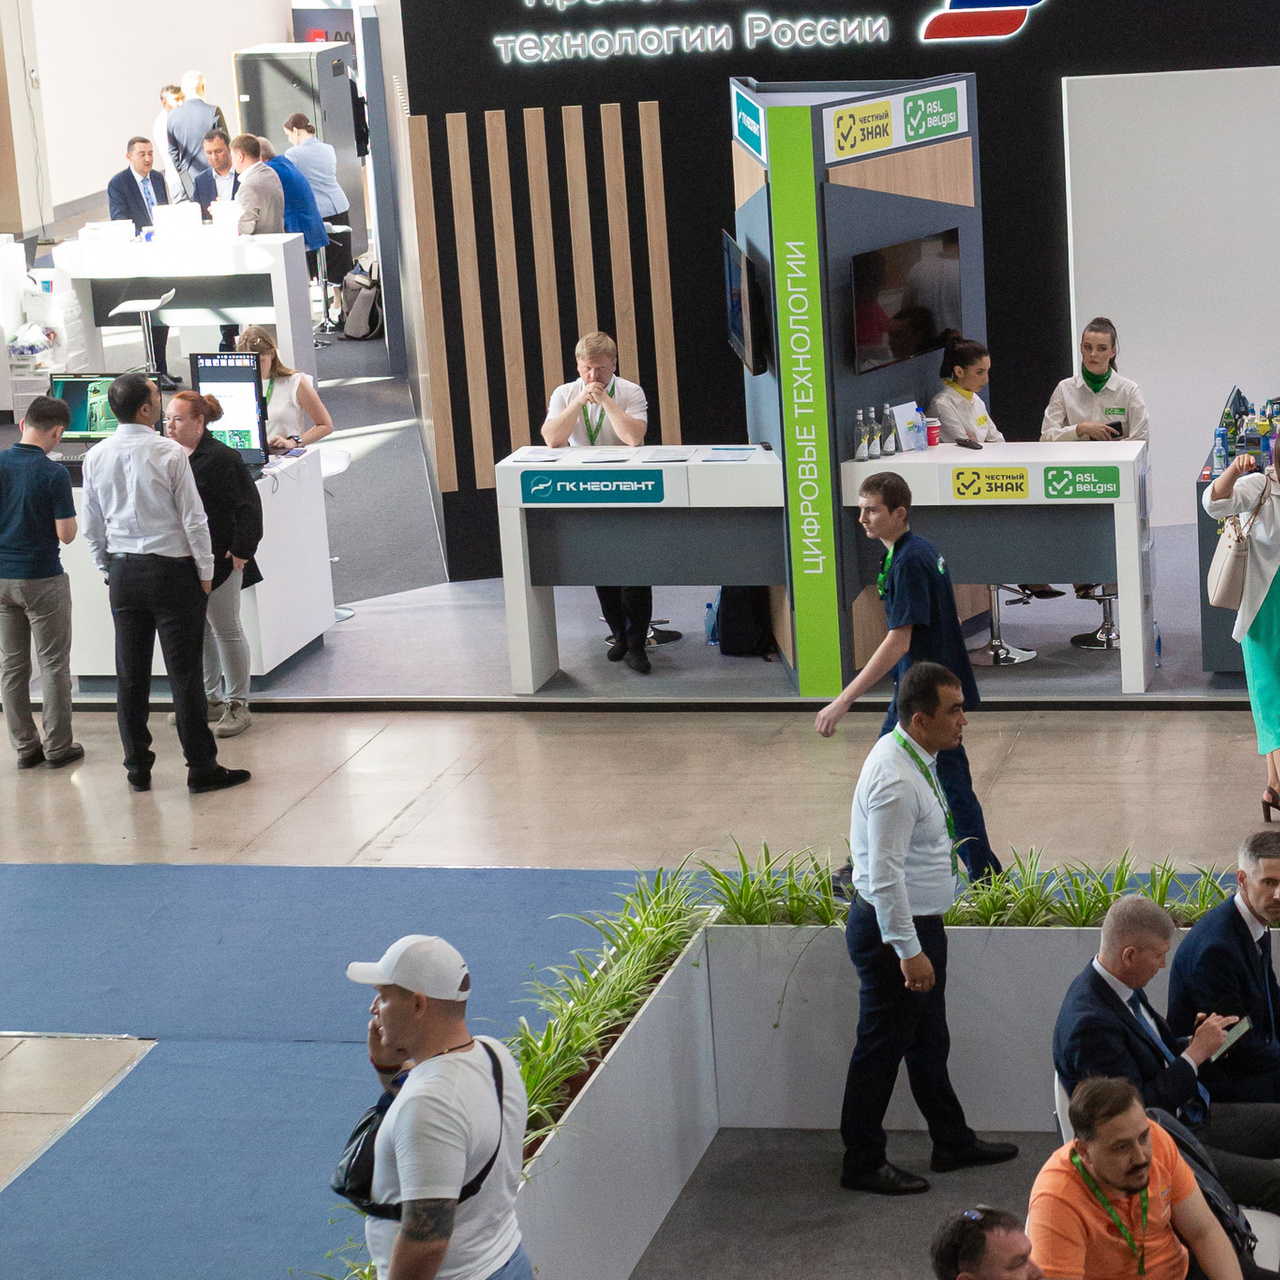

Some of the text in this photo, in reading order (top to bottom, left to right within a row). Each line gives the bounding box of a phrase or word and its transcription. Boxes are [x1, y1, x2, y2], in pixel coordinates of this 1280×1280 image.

[494, 13, 889, 63] технологии России
[926, 100, 943, 114] ASL
[859, 110, 889, 124] ЧЕСТНЫЙ
[860, 123, 889, 142] ЗНАК
[785, 241, 825, 574] ЦИФРОВЫЕ ТЕХНОЛОГИИ
[985, 473, 1025, 481] ЧЕСТНЫЙ
[1076, 473, 1098, 482] ASL
[556, 481, 577, 491] ГК
[985, 482, 1025, 492] ЗНАК
